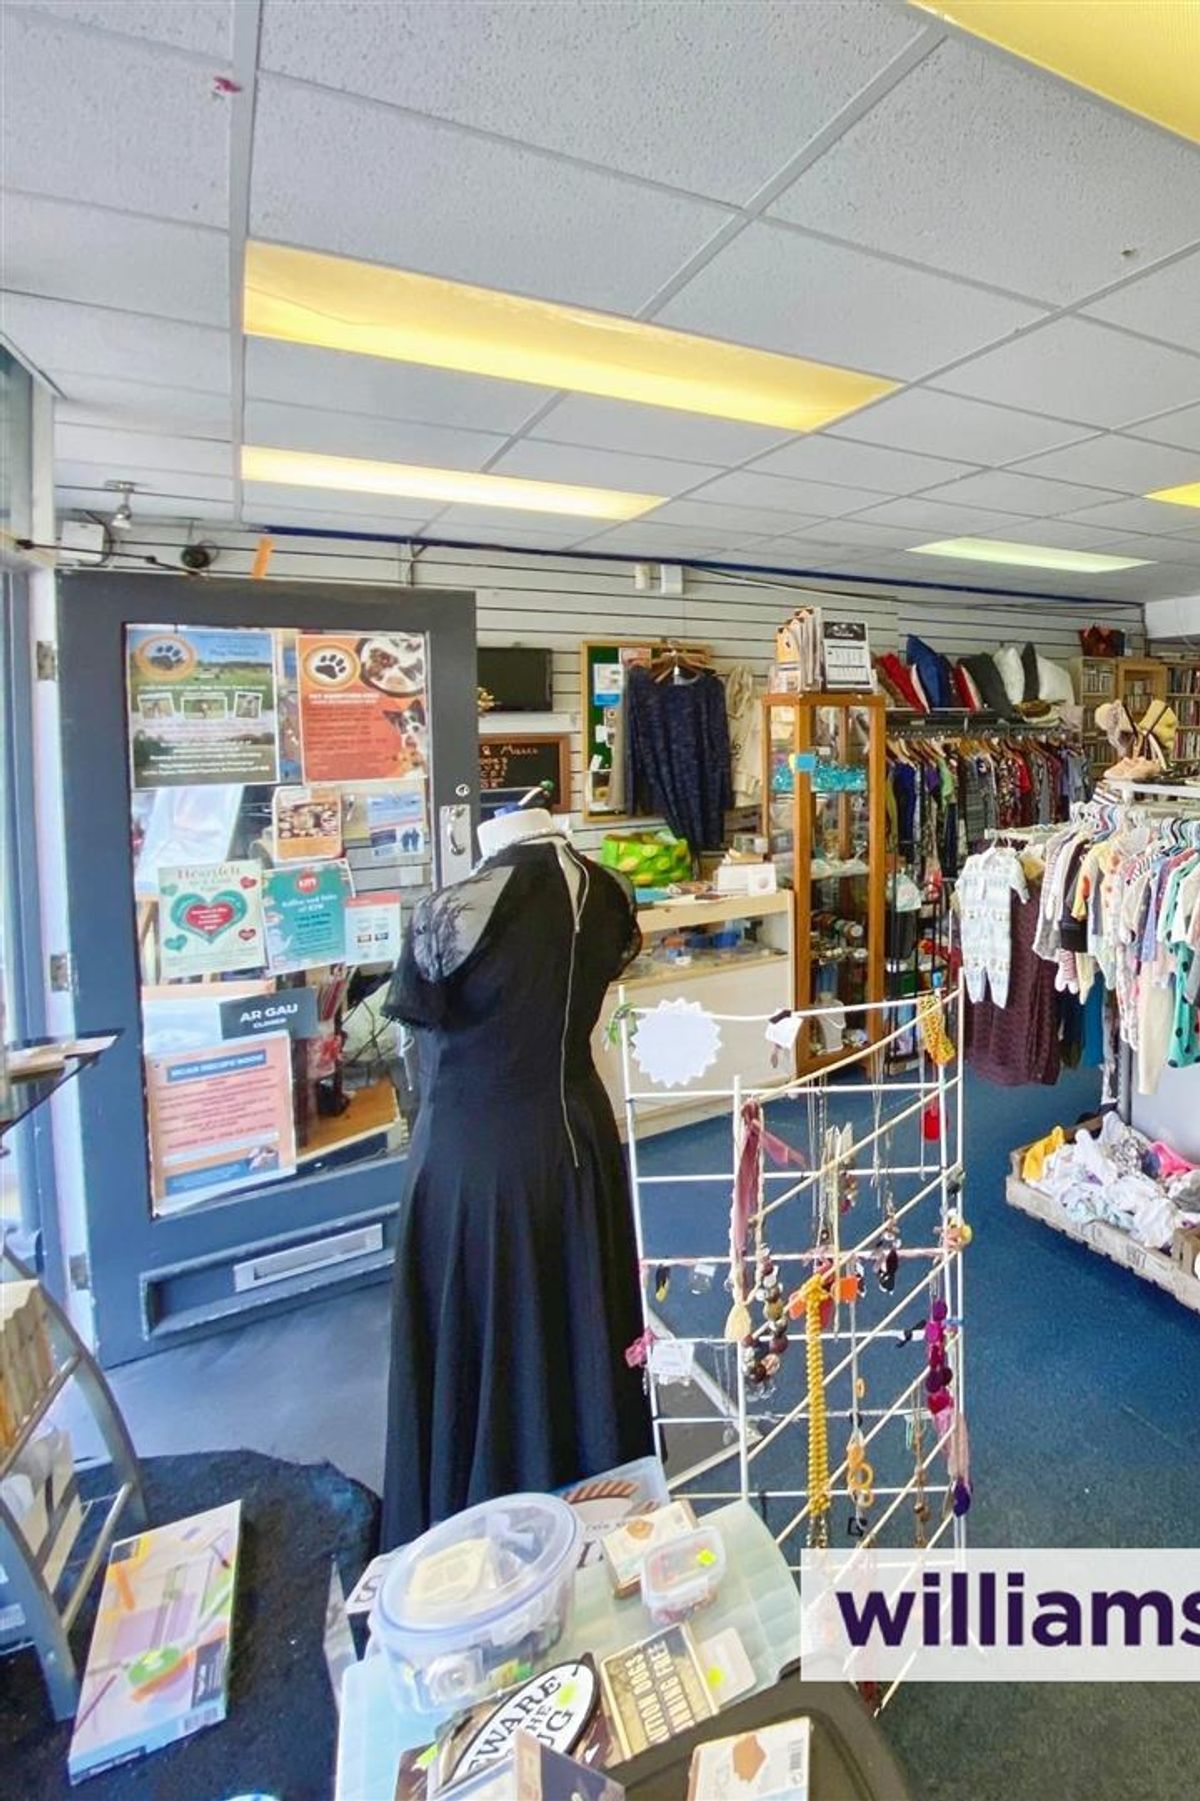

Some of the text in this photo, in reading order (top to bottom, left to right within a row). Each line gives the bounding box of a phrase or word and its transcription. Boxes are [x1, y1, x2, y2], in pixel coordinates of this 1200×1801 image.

[240, 1003, 298, 1023] AR GAU
[467, 1676, 562, 1771] WARE
[525, 1705, 551, 1732] HE
[635, 1691, 671, 1745] UTION
